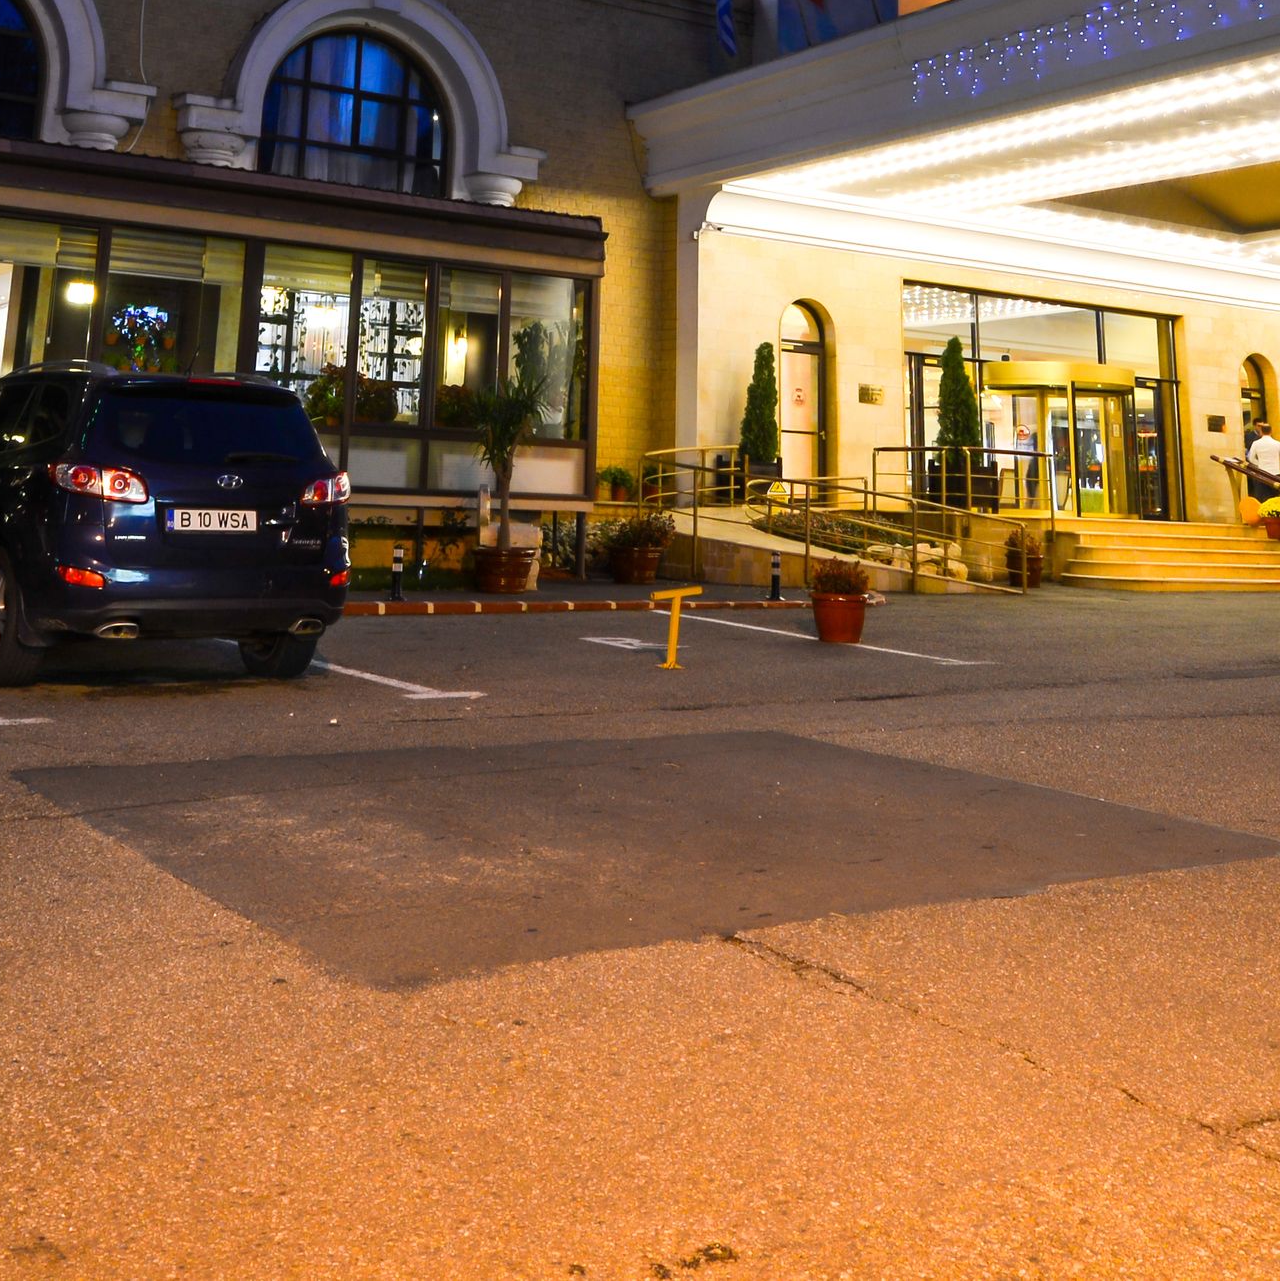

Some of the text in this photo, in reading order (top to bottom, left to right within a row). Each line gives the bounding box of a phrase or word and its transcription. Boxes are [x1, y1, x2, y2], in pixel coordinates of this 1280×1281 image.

[180, 511, 249, 529] B 10 WSA
